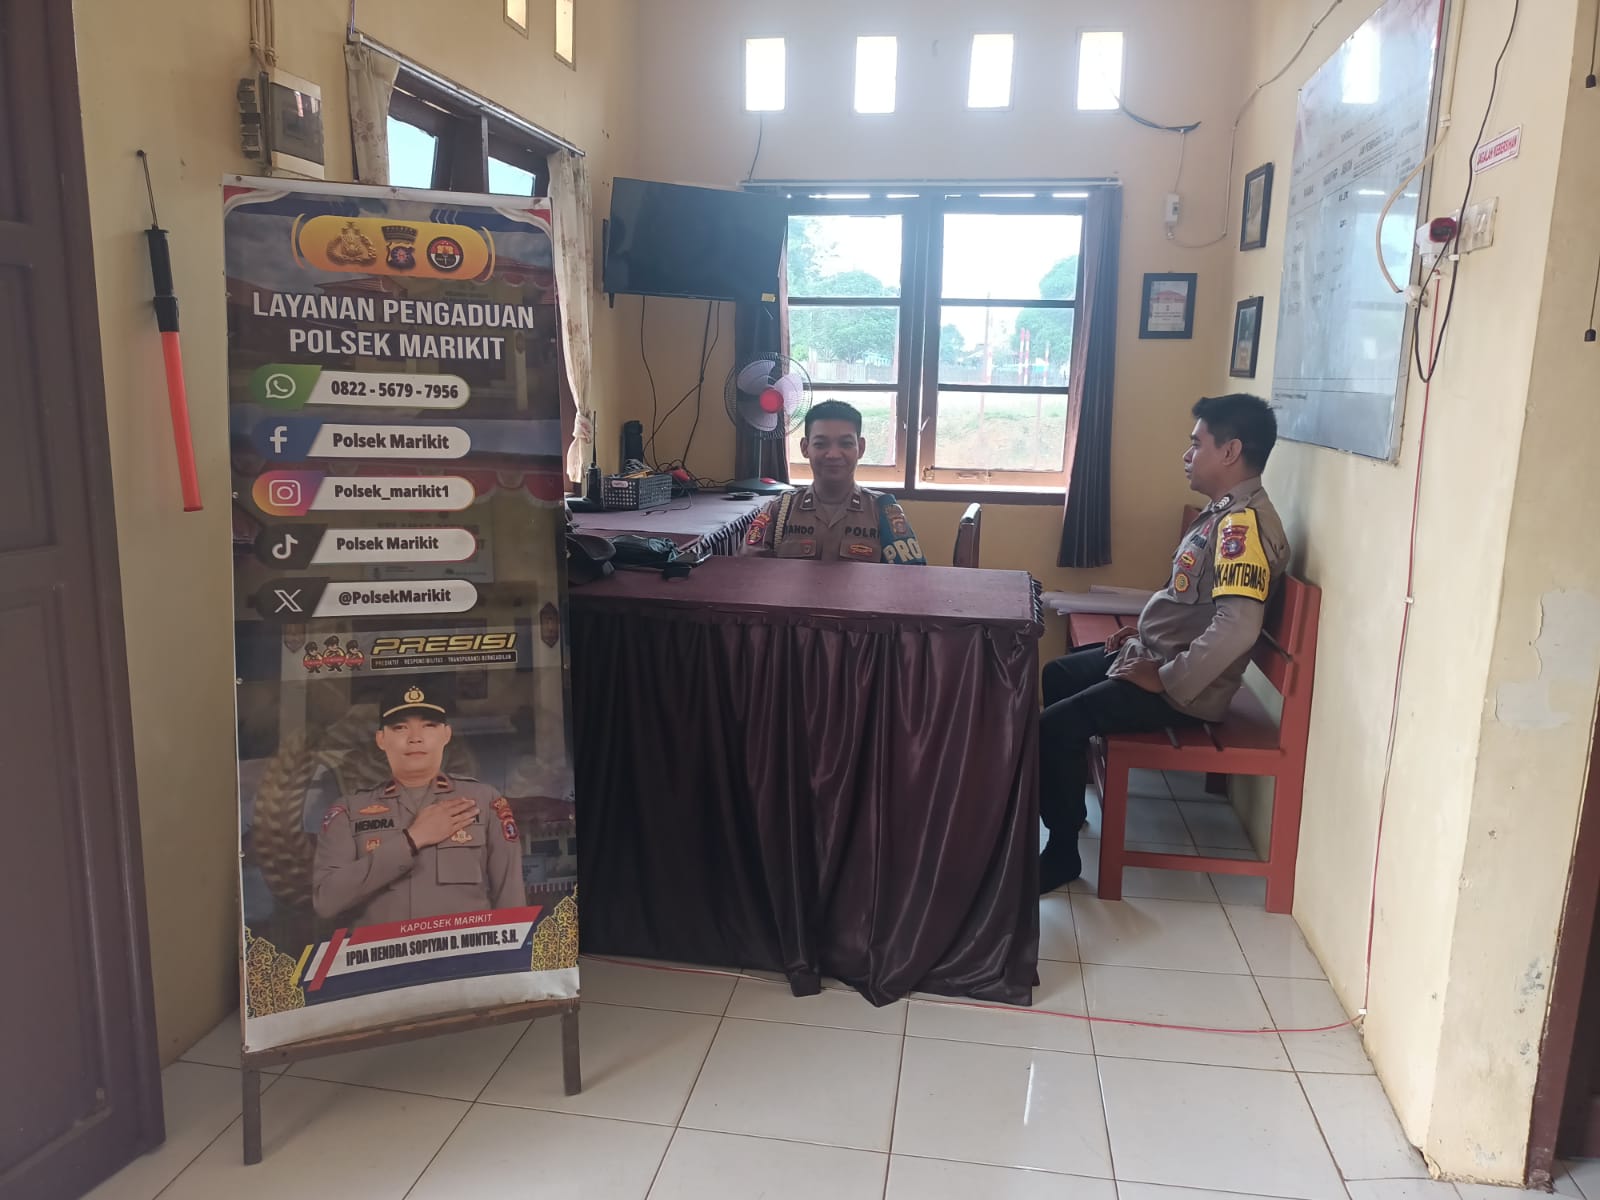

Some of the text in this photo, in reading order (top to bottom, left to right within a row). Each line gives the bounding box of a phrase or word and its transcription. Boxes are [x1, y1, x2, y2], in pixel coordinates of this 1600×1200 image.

[253, 291, 534, 329] LAYANAN PENGADUAN
[289, 328, 505, 360] POLSEK MARIKIT
[331, 380, 367, 397] 0822
[378, 382, 413, 398] 5679
[424, 384, 459, 399] 7956
[332, 432, 450, 450] Polsek Marikit
[334, 484, 449, 500] Polsek_marikit1
[336, 536, 439, 551] Polsek Marikit
[338, 588, 451, 606] @PolsekMarikit
[372, 633, 516, 655] PRESISI
[354, 818, 394, 832] HENDRA
[400, 913, 493, 934] KAPOLSEK MARIKIT
[346, 948, 370, 967] IPDA
[370, 942, 409, 963] HENDRA
[409, 935, 449, 956] SOPIYAN
[450, 935, 460, 950] D.
[501, 928, 519, 945] S.H.
